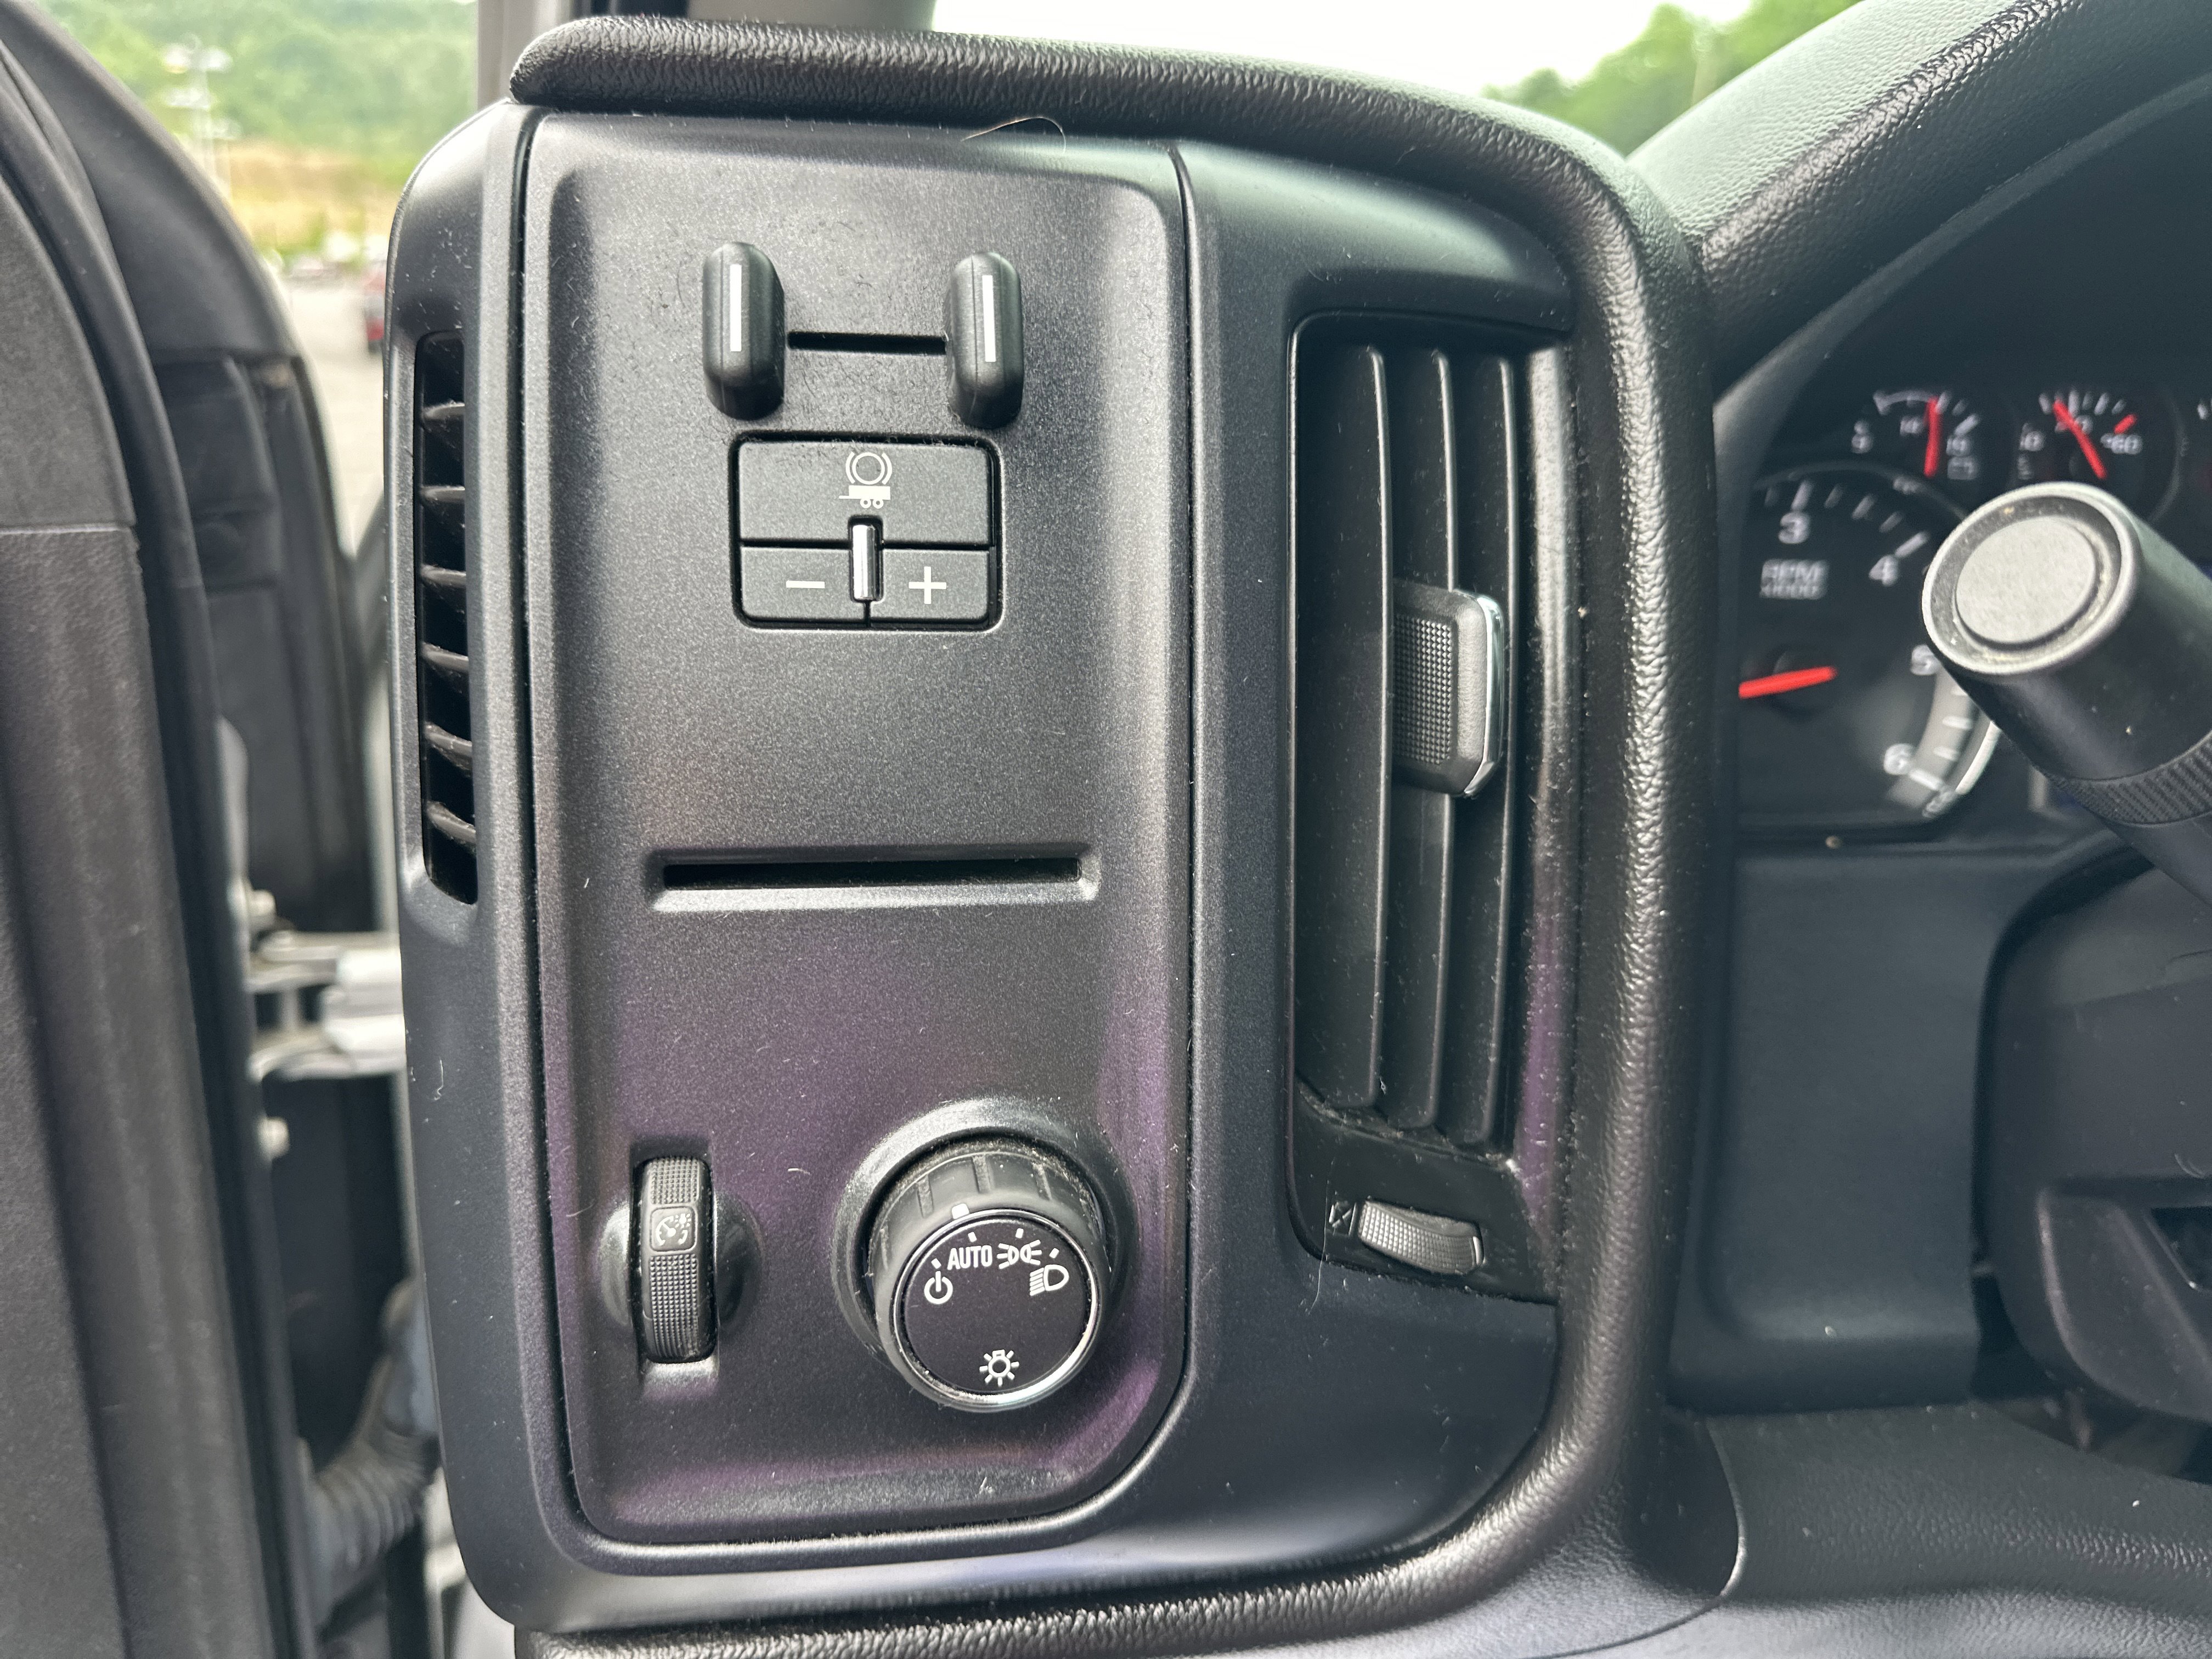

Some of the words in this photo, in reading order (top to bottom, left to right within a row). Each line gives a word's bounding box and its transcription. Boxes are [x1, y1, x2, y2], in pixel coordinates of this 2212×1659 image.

[1779, 511, 1810, 544] 3
[1869, 555, 1899, 586] 4
[1884, 743, 1915, 775] 6
[947, 1245, 993, 1270] AUTO
